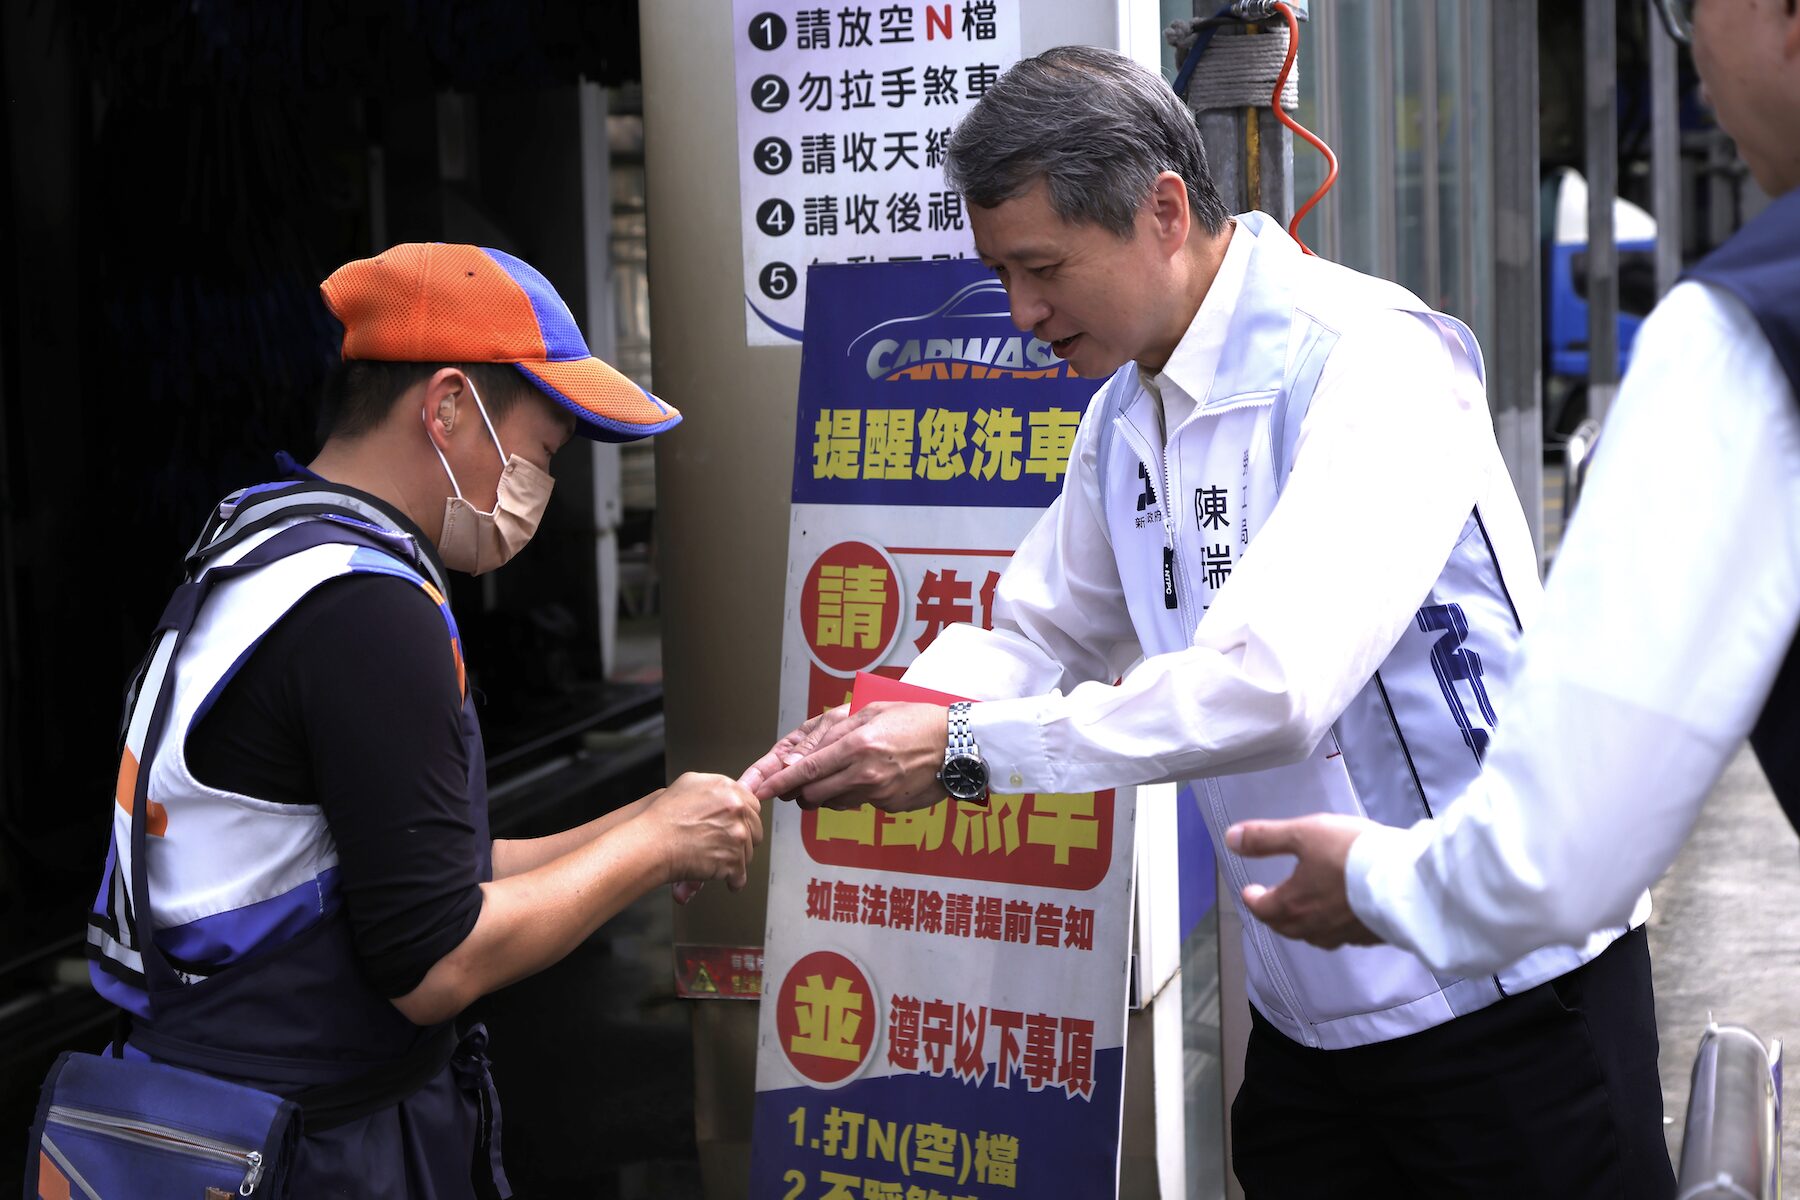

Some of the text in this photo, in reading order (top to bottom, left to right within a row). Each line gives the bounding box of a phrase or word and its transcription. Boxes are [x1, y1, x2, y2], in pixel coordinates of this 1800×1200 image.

[796, 0, 997, 50] 請放空N檔
[799, 62, 1000, 112] 勿拉手煞車
[812, 407, 1081, 482] 提醒您洗車
[1164, 569, 1173, 595] NTPC
[1195, 485, 1232, 613] 陳瑞
[816, 564, 888, 649] 請
[805, 877, 1096, 951] 如無法解除請提前告知
[790, 973, 1096, 1102] 並 遵守以下事項
